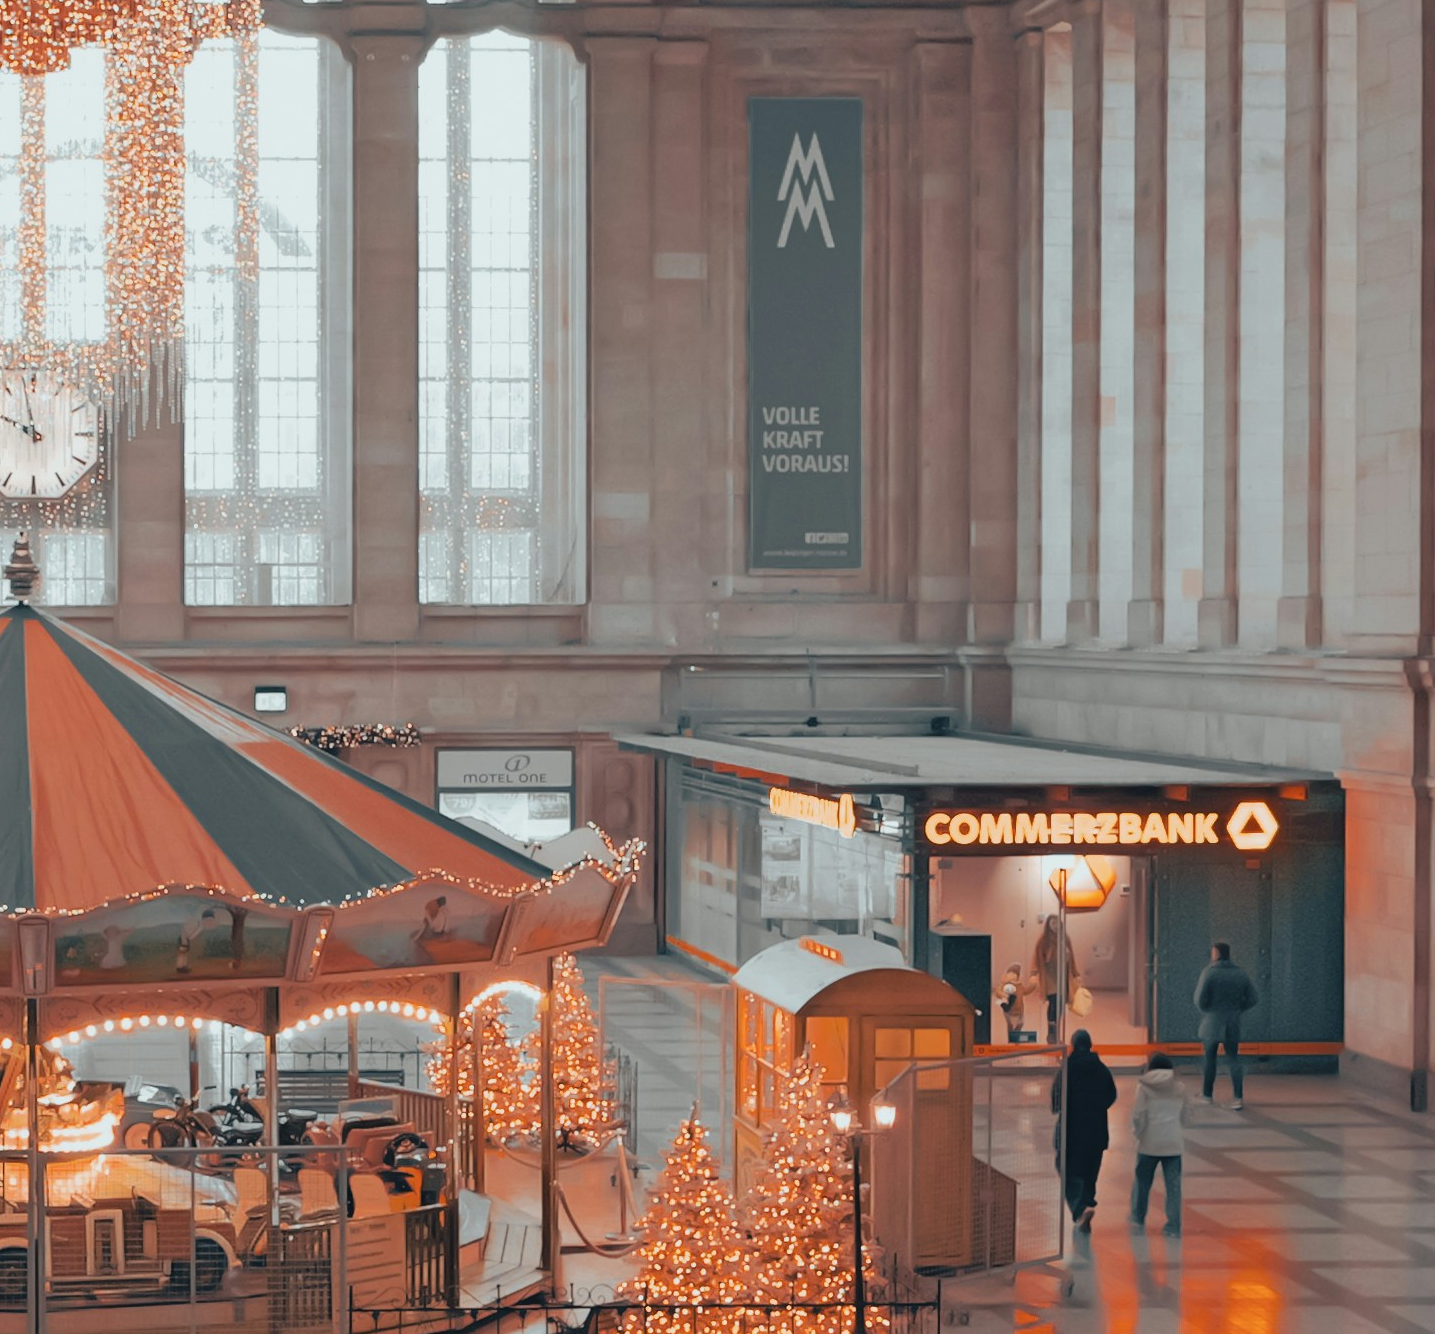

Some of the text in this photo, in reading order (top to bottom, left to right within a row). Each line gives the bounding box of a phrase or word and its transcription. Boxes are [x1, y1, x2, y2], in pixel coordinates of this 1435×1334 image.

[762, 406, 820, 425] VOLLE
[762, 430, 824, 449] KRAFT
[762, 454, 850, 473] VORAUS!
[463, 773, 547, 784] MOTEL ONE
[924, 812, 1219, 844] COMMERZBANK
